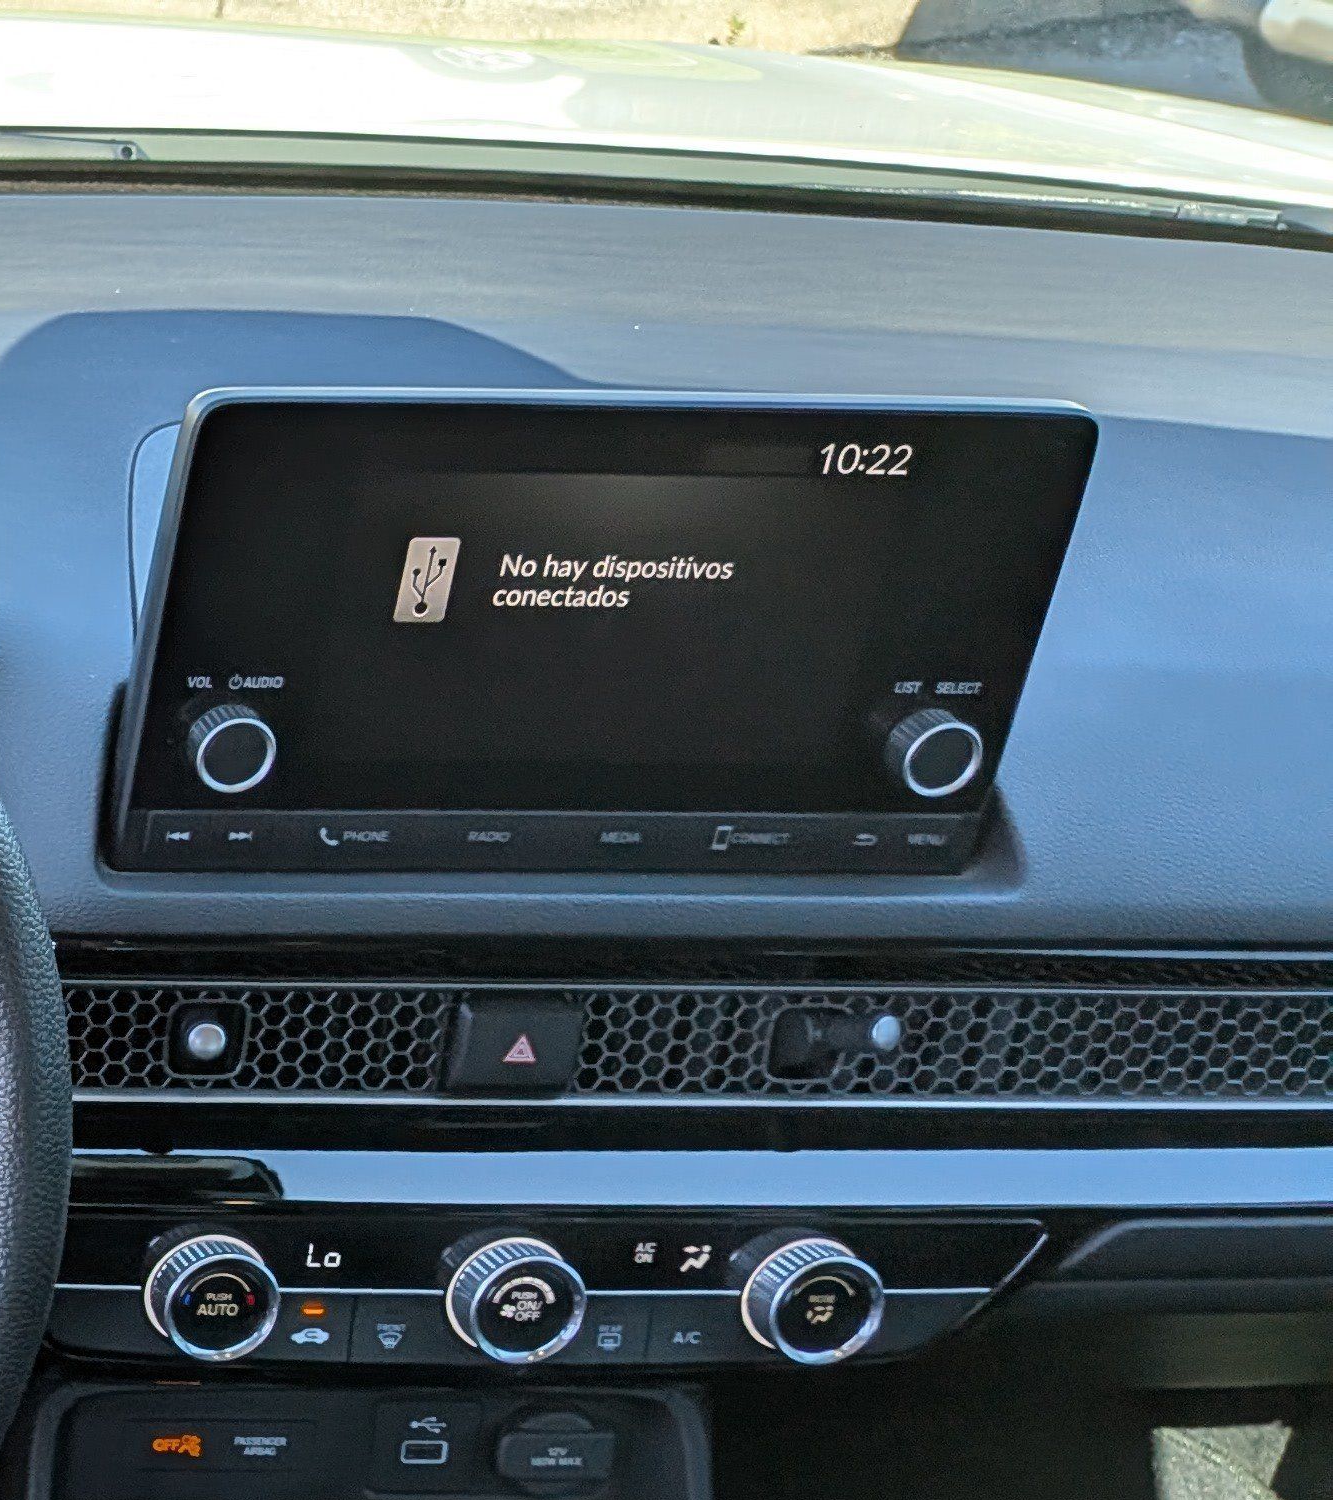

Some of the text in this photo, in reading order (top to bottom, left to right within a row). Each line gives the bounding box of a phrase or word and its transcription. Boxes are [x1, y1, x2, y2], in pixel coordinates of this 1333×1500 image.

[820, 443, 913, 476] 10:22
[499, 553, 734, 583] No hay dispositivos
[491, 585, 631, 608] conectados
[187, 676, 285, 689] VOL AUDIO
[894, 681, 923, 694] LIST
[935, 682, 983, 695] SELECT
[306, 1243, 342, 1268] Lo
[634, 1253, 653, 1264] ON
[206, 1292, 232, 1301] PUSH
[196, 1303, 239, 1317] AUTO
[514, 1310, 541, 1321] OFF
[673, 1331, 701, 1344] A/C
[153, 1438, 180, 1452] OFF
